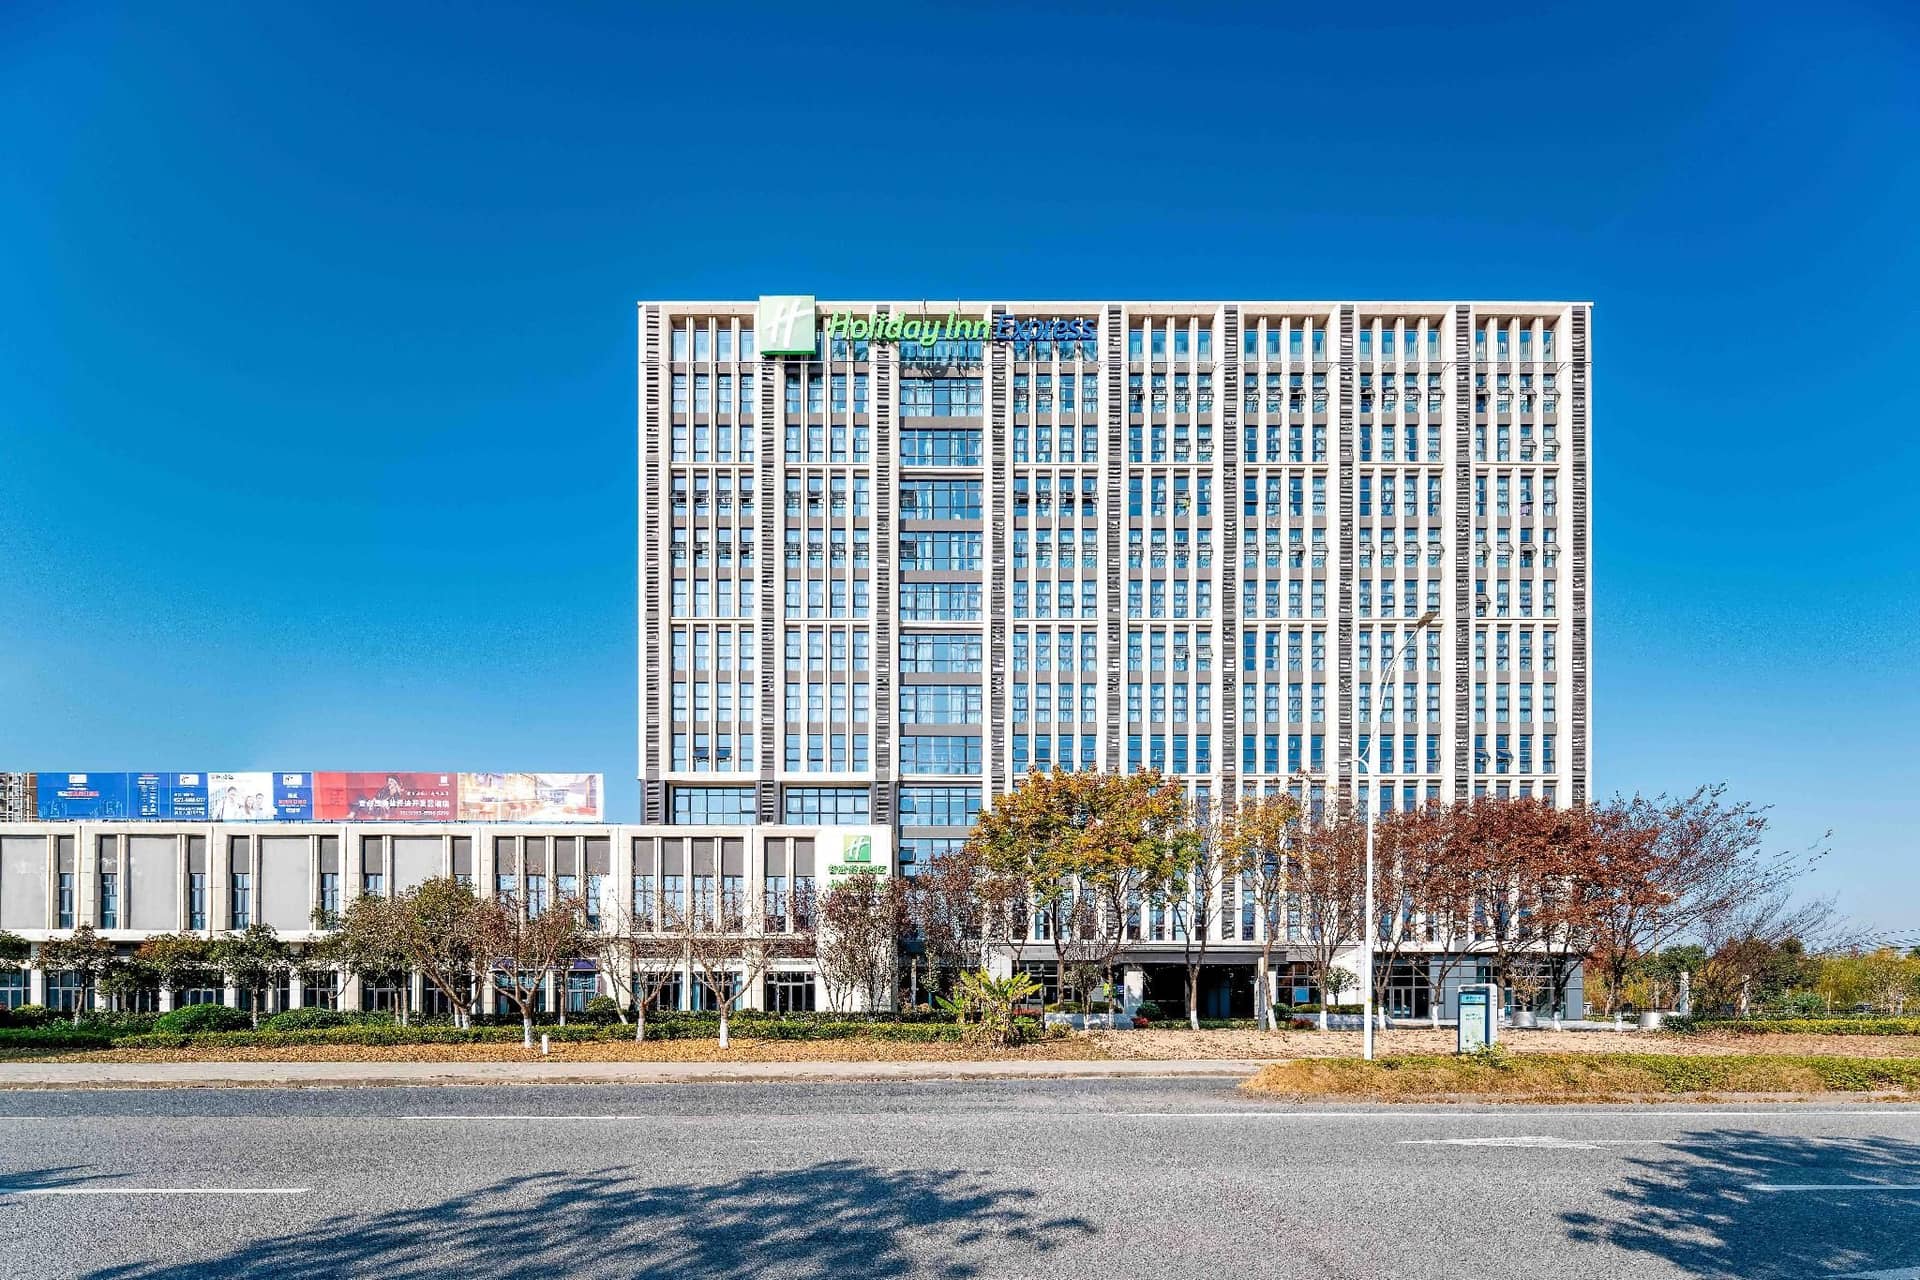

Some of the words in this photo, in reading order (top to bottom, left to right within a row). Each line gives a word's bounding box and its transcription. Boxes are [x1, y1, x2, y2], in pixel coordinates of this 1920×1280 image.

[828, 309, 941, 347] Holiday
[944, 309, 991, 341] Inn
[996, 314, 1096, 349] Express
